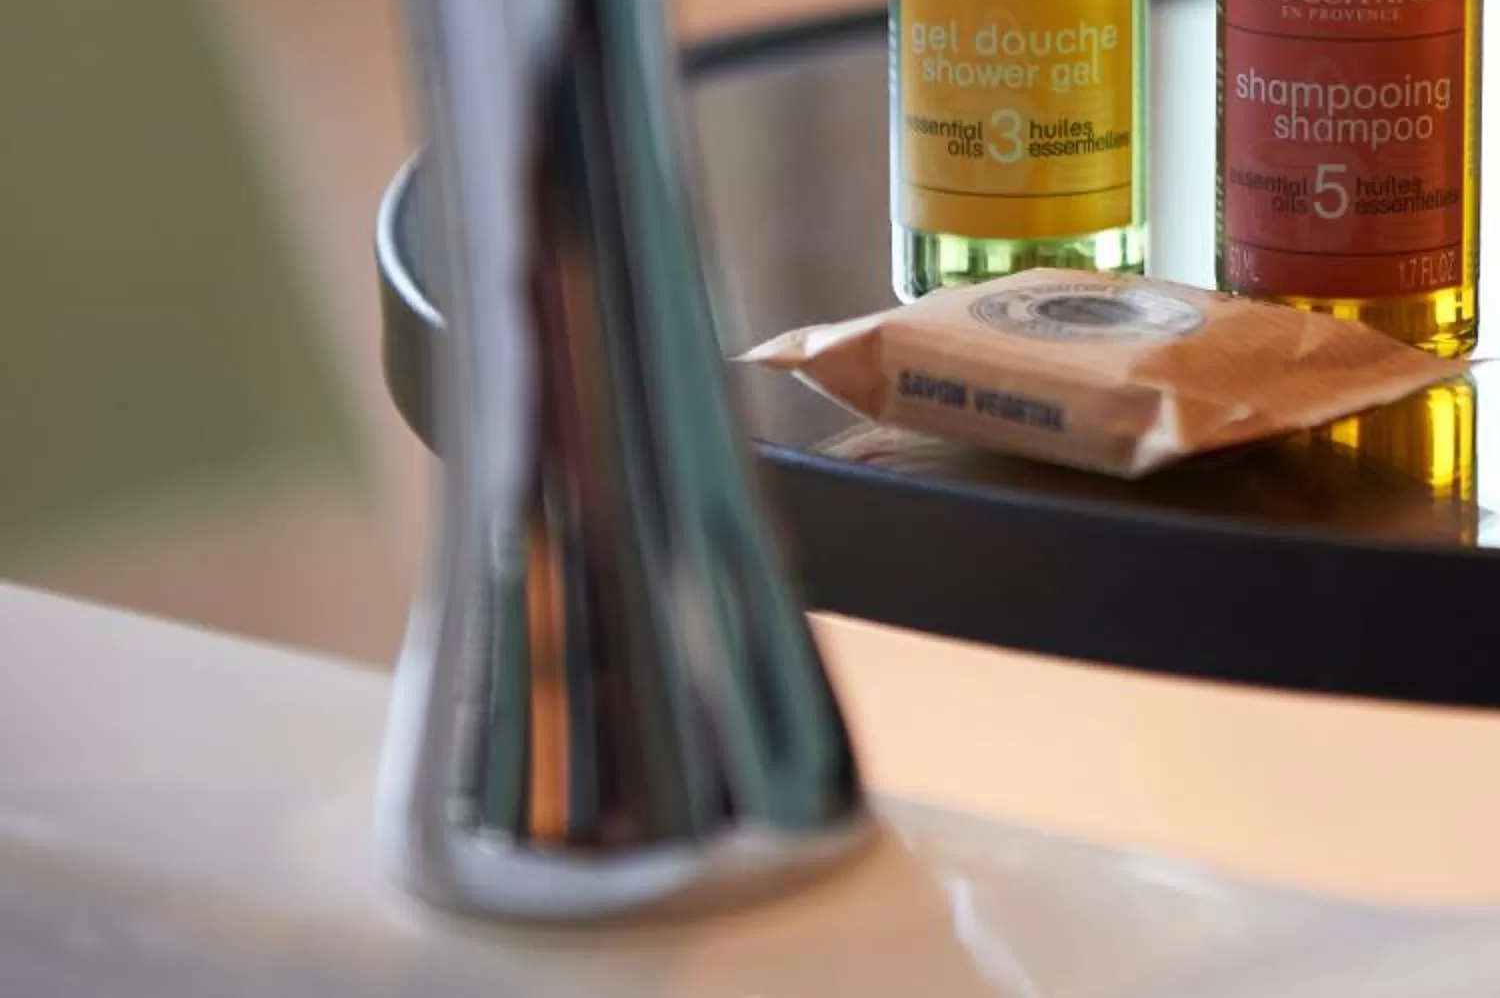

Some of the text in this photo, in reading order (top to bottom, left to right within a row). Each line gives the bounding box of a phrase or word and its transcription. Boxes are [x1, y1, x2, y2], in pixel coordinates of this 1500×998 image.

[911, 20, 1118, 57] gel douche
[922, 54, 1100, 94] shower gel
[1236, 67, 1452, 117] shampooing
[947, 138, 984, 159] oils
[987, 107, 1025, 166] 3
[1028, 118, 1094, 140] huiles
[1273, 107, 1434, 151] shampoo
[1313, 162, 1349, 220] 5
